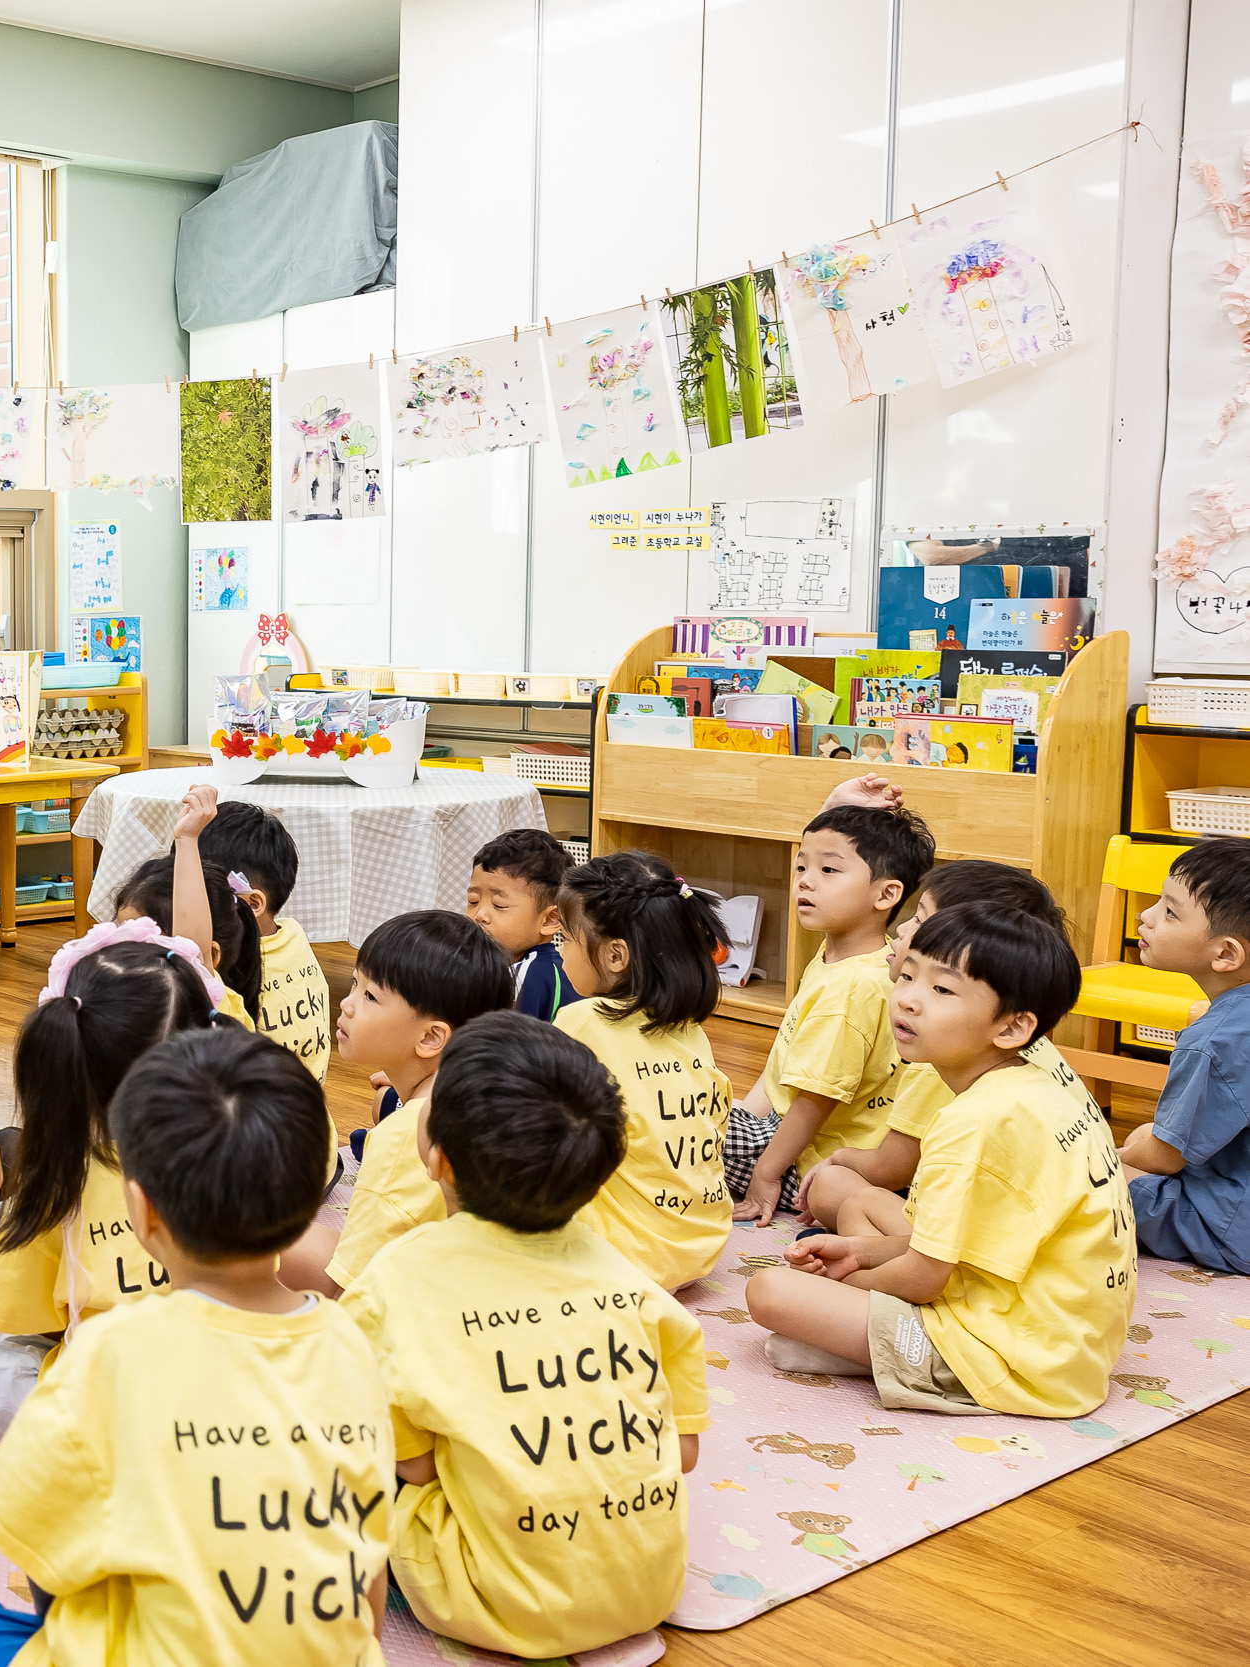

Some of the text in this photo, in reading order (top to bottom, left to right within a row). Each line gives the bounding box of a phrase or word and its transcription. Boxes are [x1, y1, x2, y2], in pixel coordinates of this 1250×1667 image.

[590, 511, 702, 525] 시현이언니, 시현이 누나가
[612, 536, 702, 549] 그려준 초등학교 교실
[934, 606, 947, 620] 14
[1189, 597, 1250, 614] 벚꽃나
[860, 705, 887, 717] 내가
[285, 973, 293, 984] a
[262, 987, 326, 1022] Lucky
[635, 1058, 702, 1080] Have a
[1055, 1120, 1088, 1153] Have
[654, 1181, 730, 1215] day tod
[462, 1309, 542, 1336] Have
[561, 1301, 577, 1316] a
[496, 1329, 659, 1393] Lucky
[174, 1420, 270, 1452] Have
[291, 1424, 307, 1444] a
[510, 1400, 664, 1466] Vicky
[212, 1468, 385, 1543] Lucky
[518, 1481, 678, 1541] day today
[219, 1551, 366, 1625] Vick
